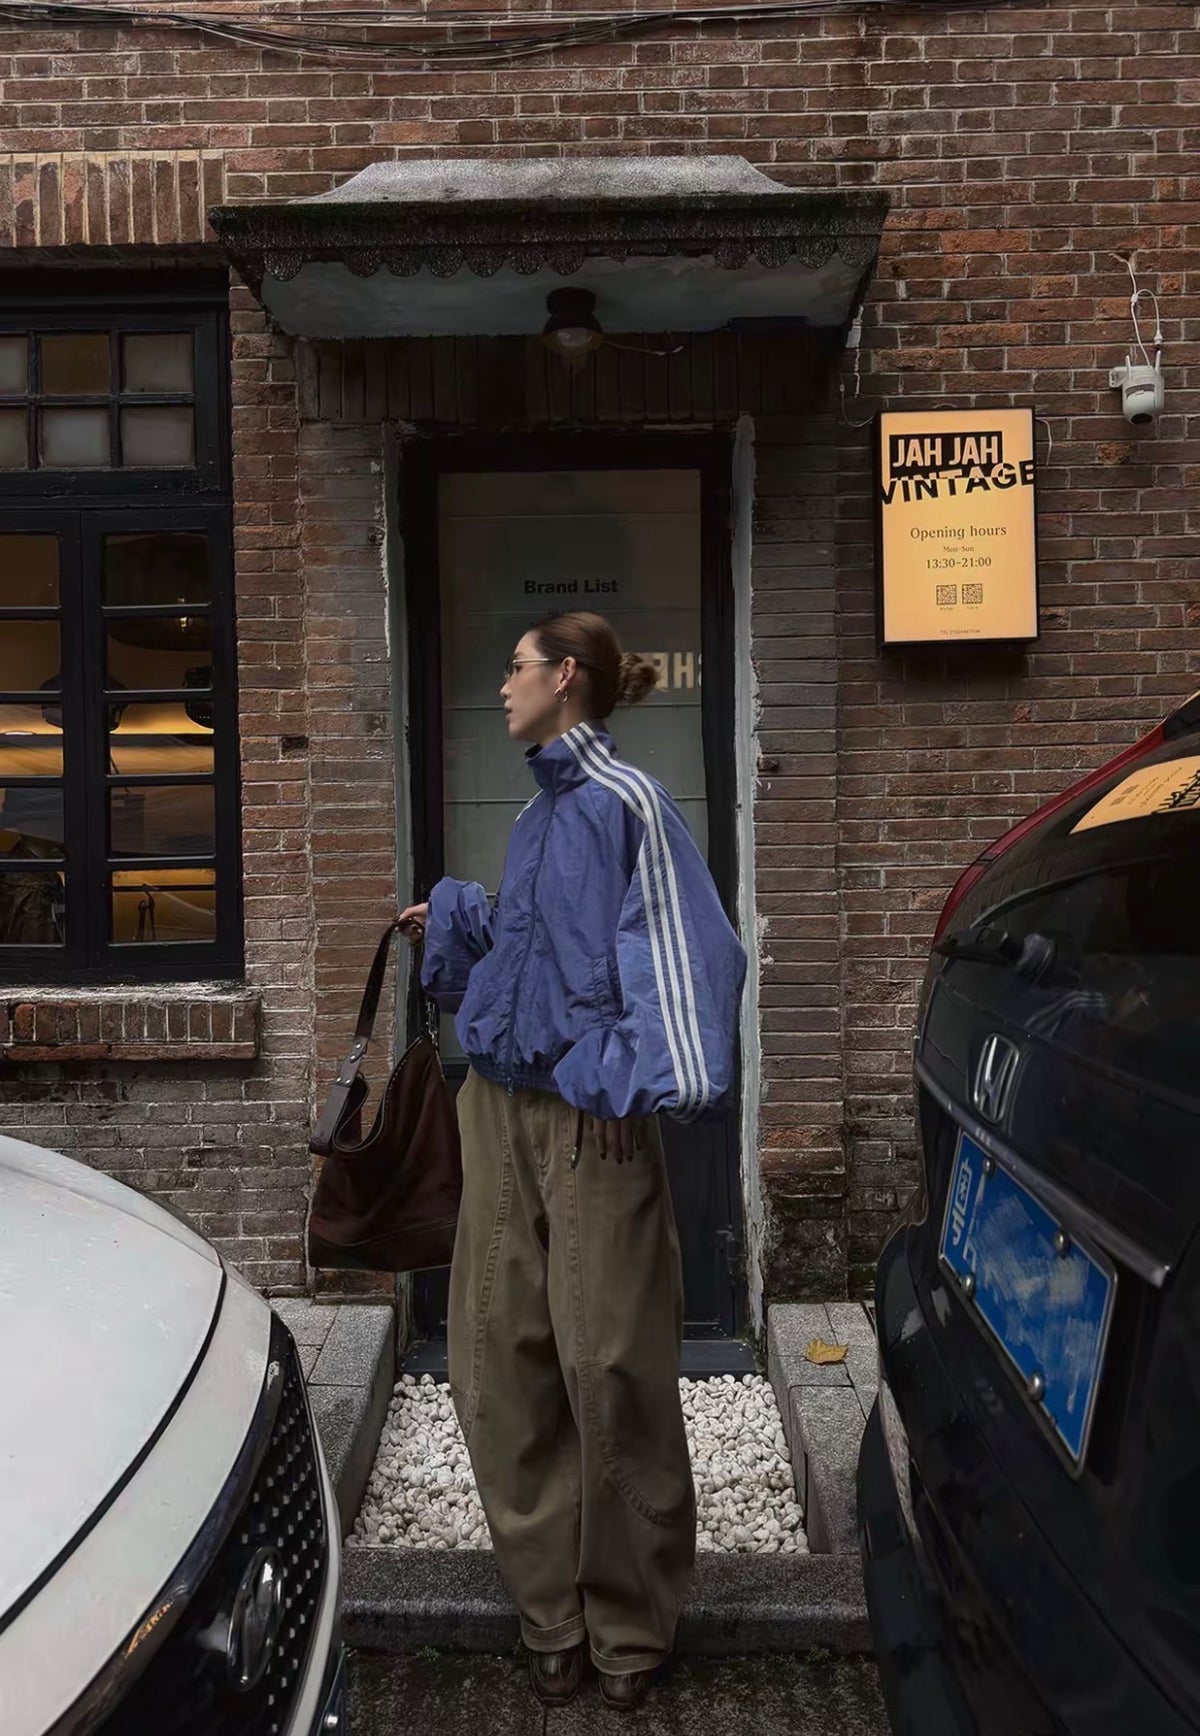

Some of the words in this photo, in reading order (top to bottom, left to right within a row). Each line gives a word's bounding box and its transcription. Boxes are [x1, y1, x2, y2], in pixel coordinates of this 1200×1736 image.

[892, 438, 942, 468] JAH
[948, 436, 999, 466] JAH
[881, 459, 1035, 505] VINTAGE
[910, 525, 965, 542] Opening
[970, 524, 1007, 537] hours
[926, 557, 992, 569] 13:30-21:00
[524, 579, 578, 594] Brand
[584, 578, 619, 593] List
